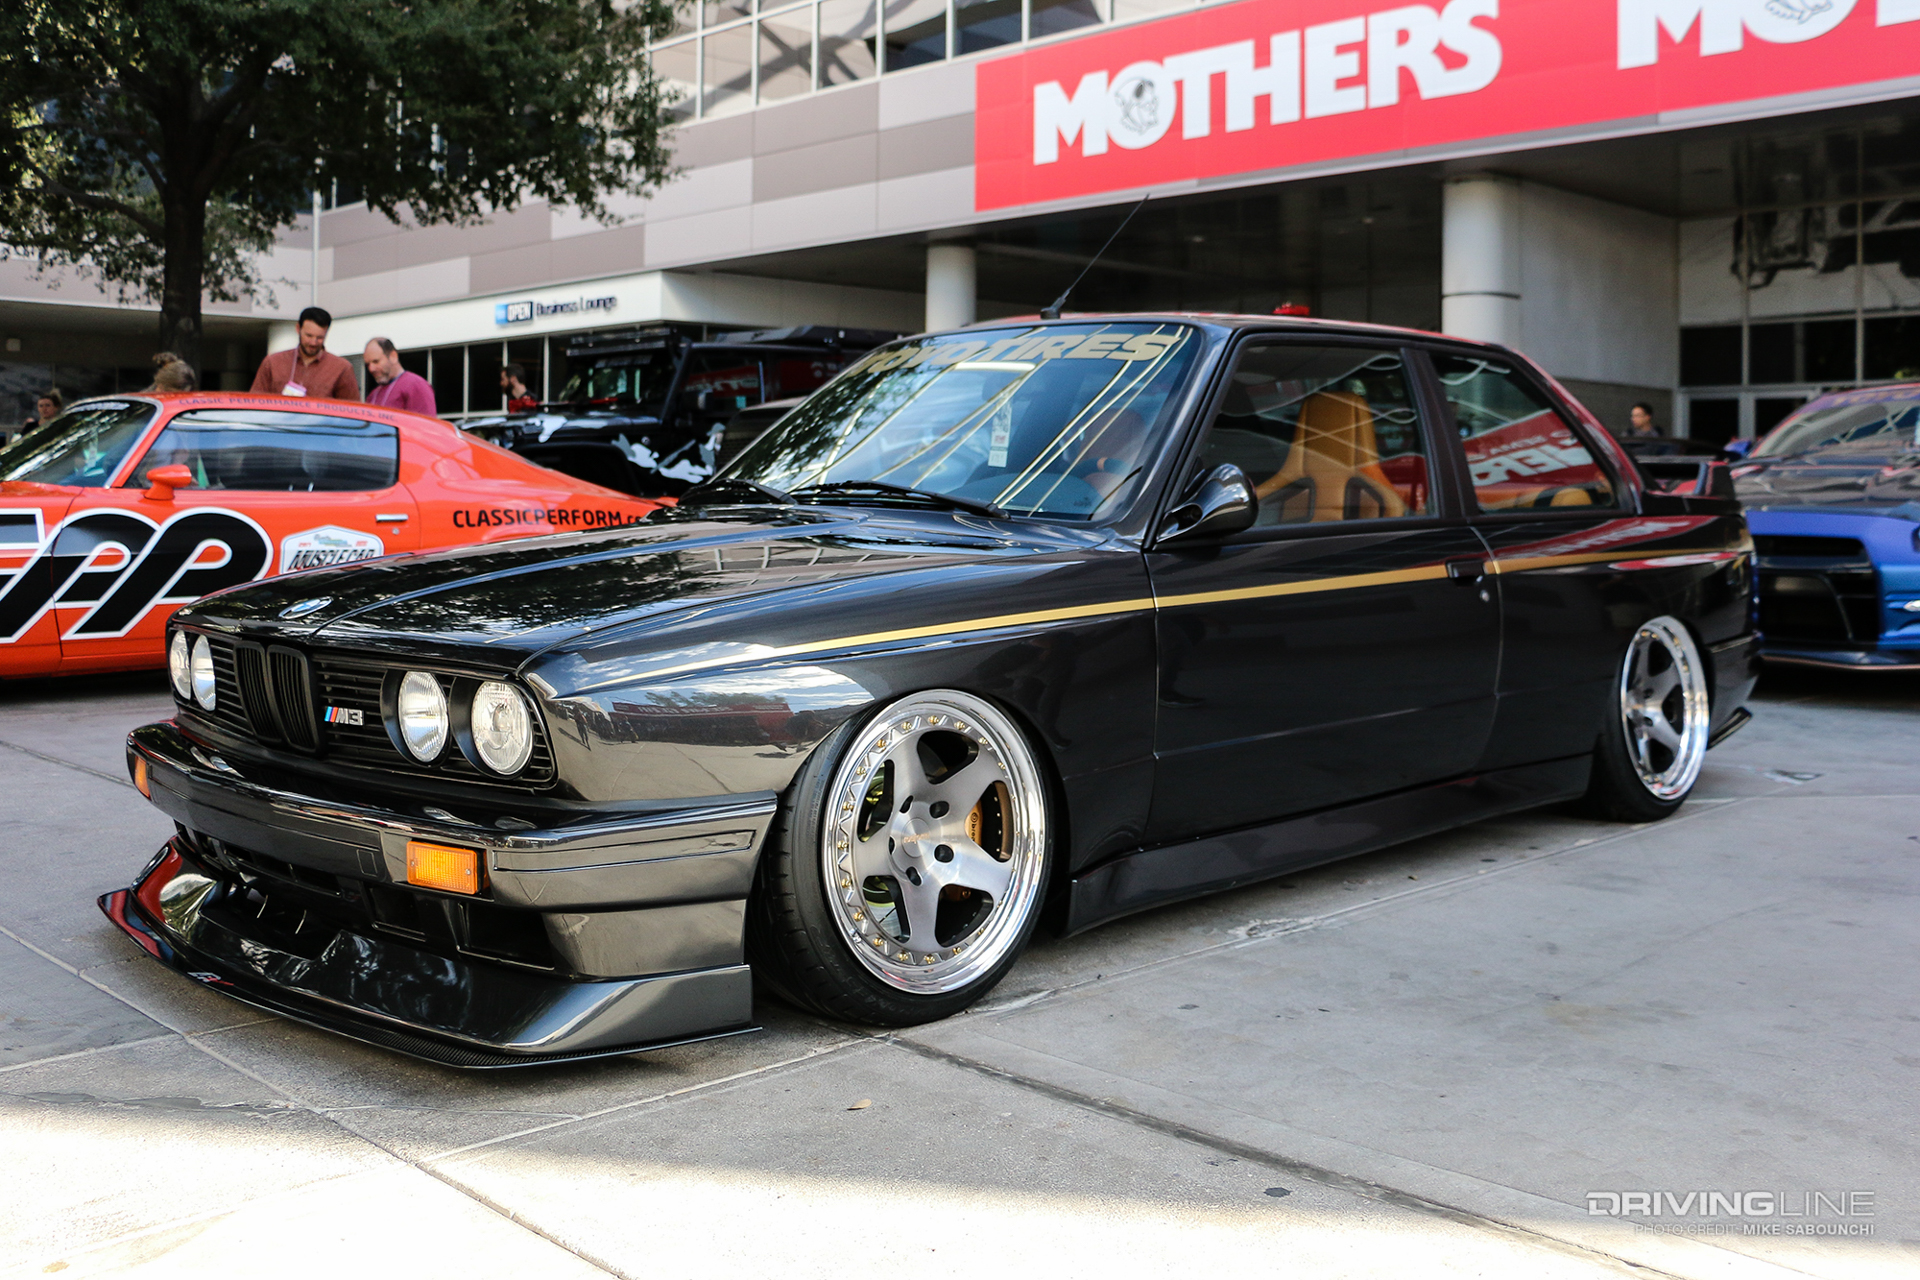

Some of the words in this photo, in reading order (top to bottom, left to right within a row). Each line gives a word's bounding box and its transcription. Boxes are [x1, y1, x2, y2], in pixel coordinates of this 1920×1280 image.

[1034, 0, 1503, 166] MOTHERS
[507, 302, 533, 322] OPEN
[536, 301, 579, 316] Business
[580, 296, 618, 311] Lounge
[178, 397, 225, 406] CLASSIC
[228, 397, 312, 409] PERFORMANCE
